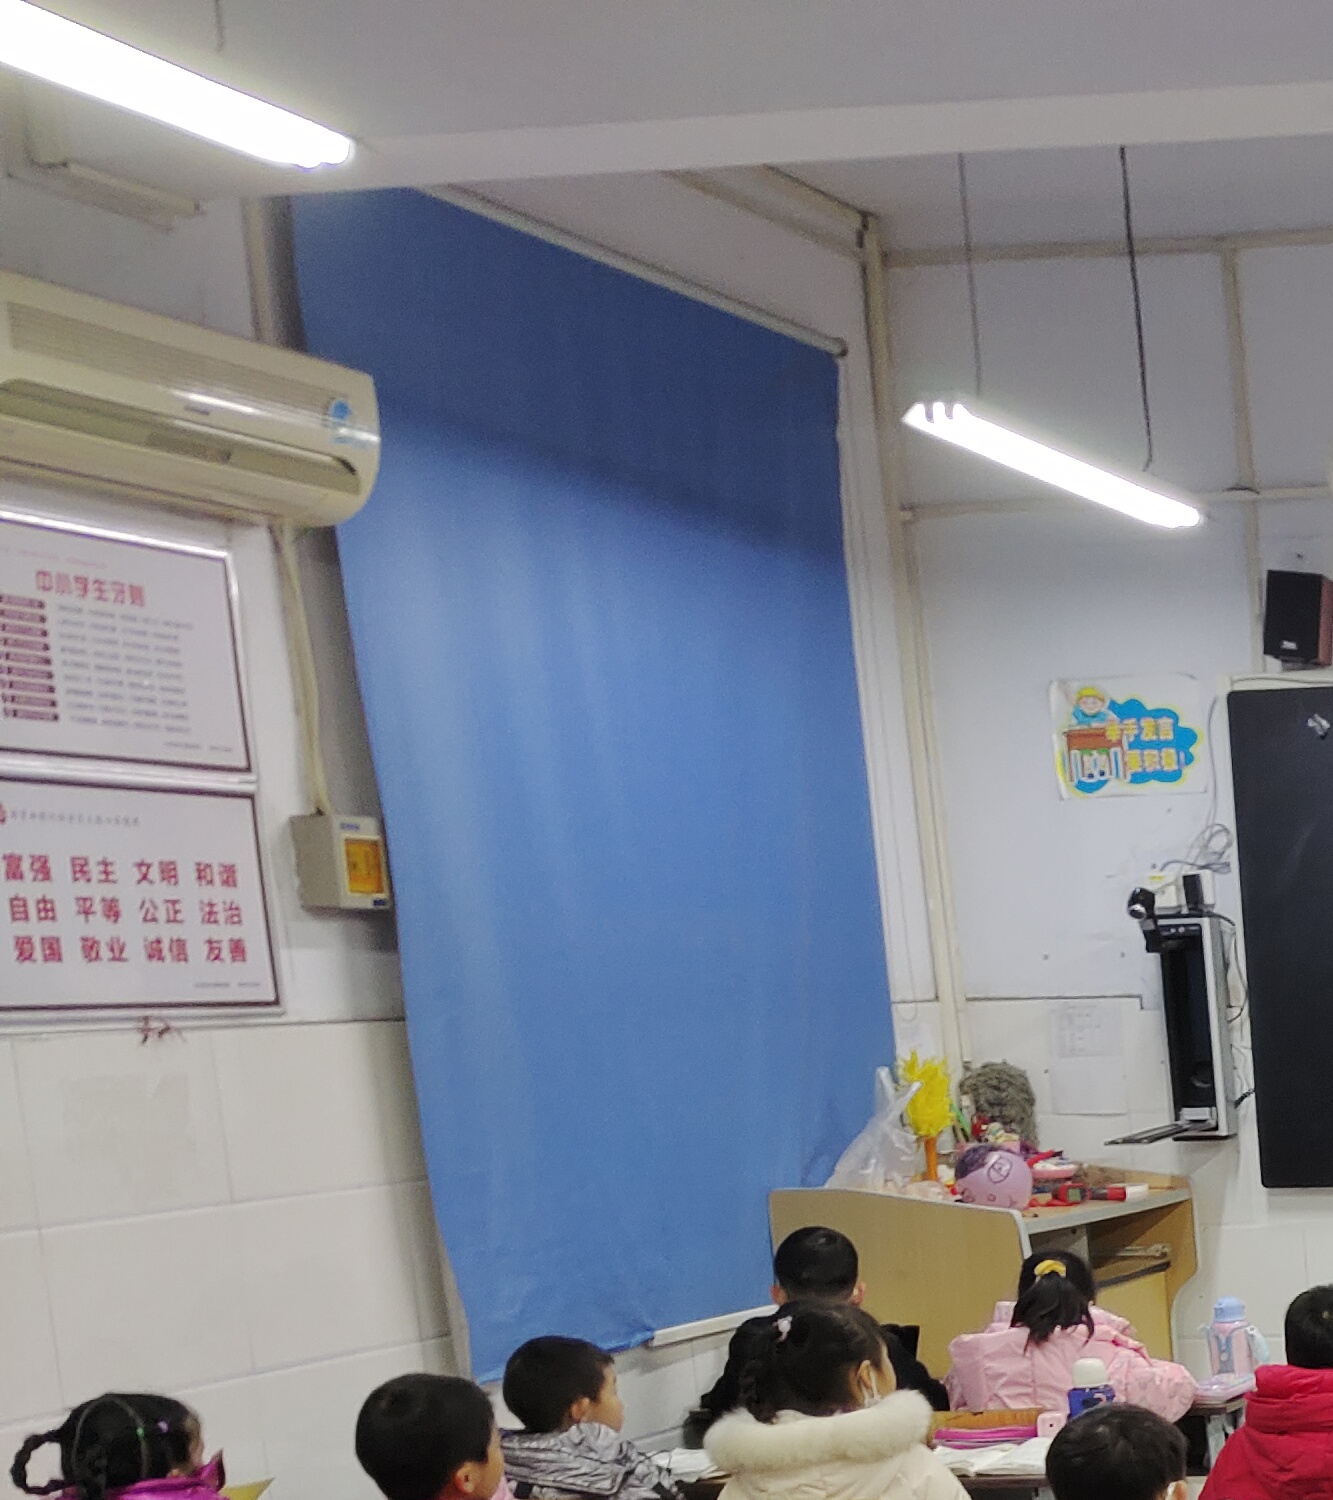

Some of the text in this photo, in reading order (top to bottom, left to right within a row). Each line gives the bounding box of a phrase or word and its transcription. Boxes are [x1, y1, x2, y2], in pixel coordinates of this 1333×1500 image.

[3, 854, 239, 888] 富强 民主 文明 和谐
[9, 896, 243, 926] 自由 平等 公正 法治
[14, 935, 247, 963] 爱国 敬业 诚信 友善
